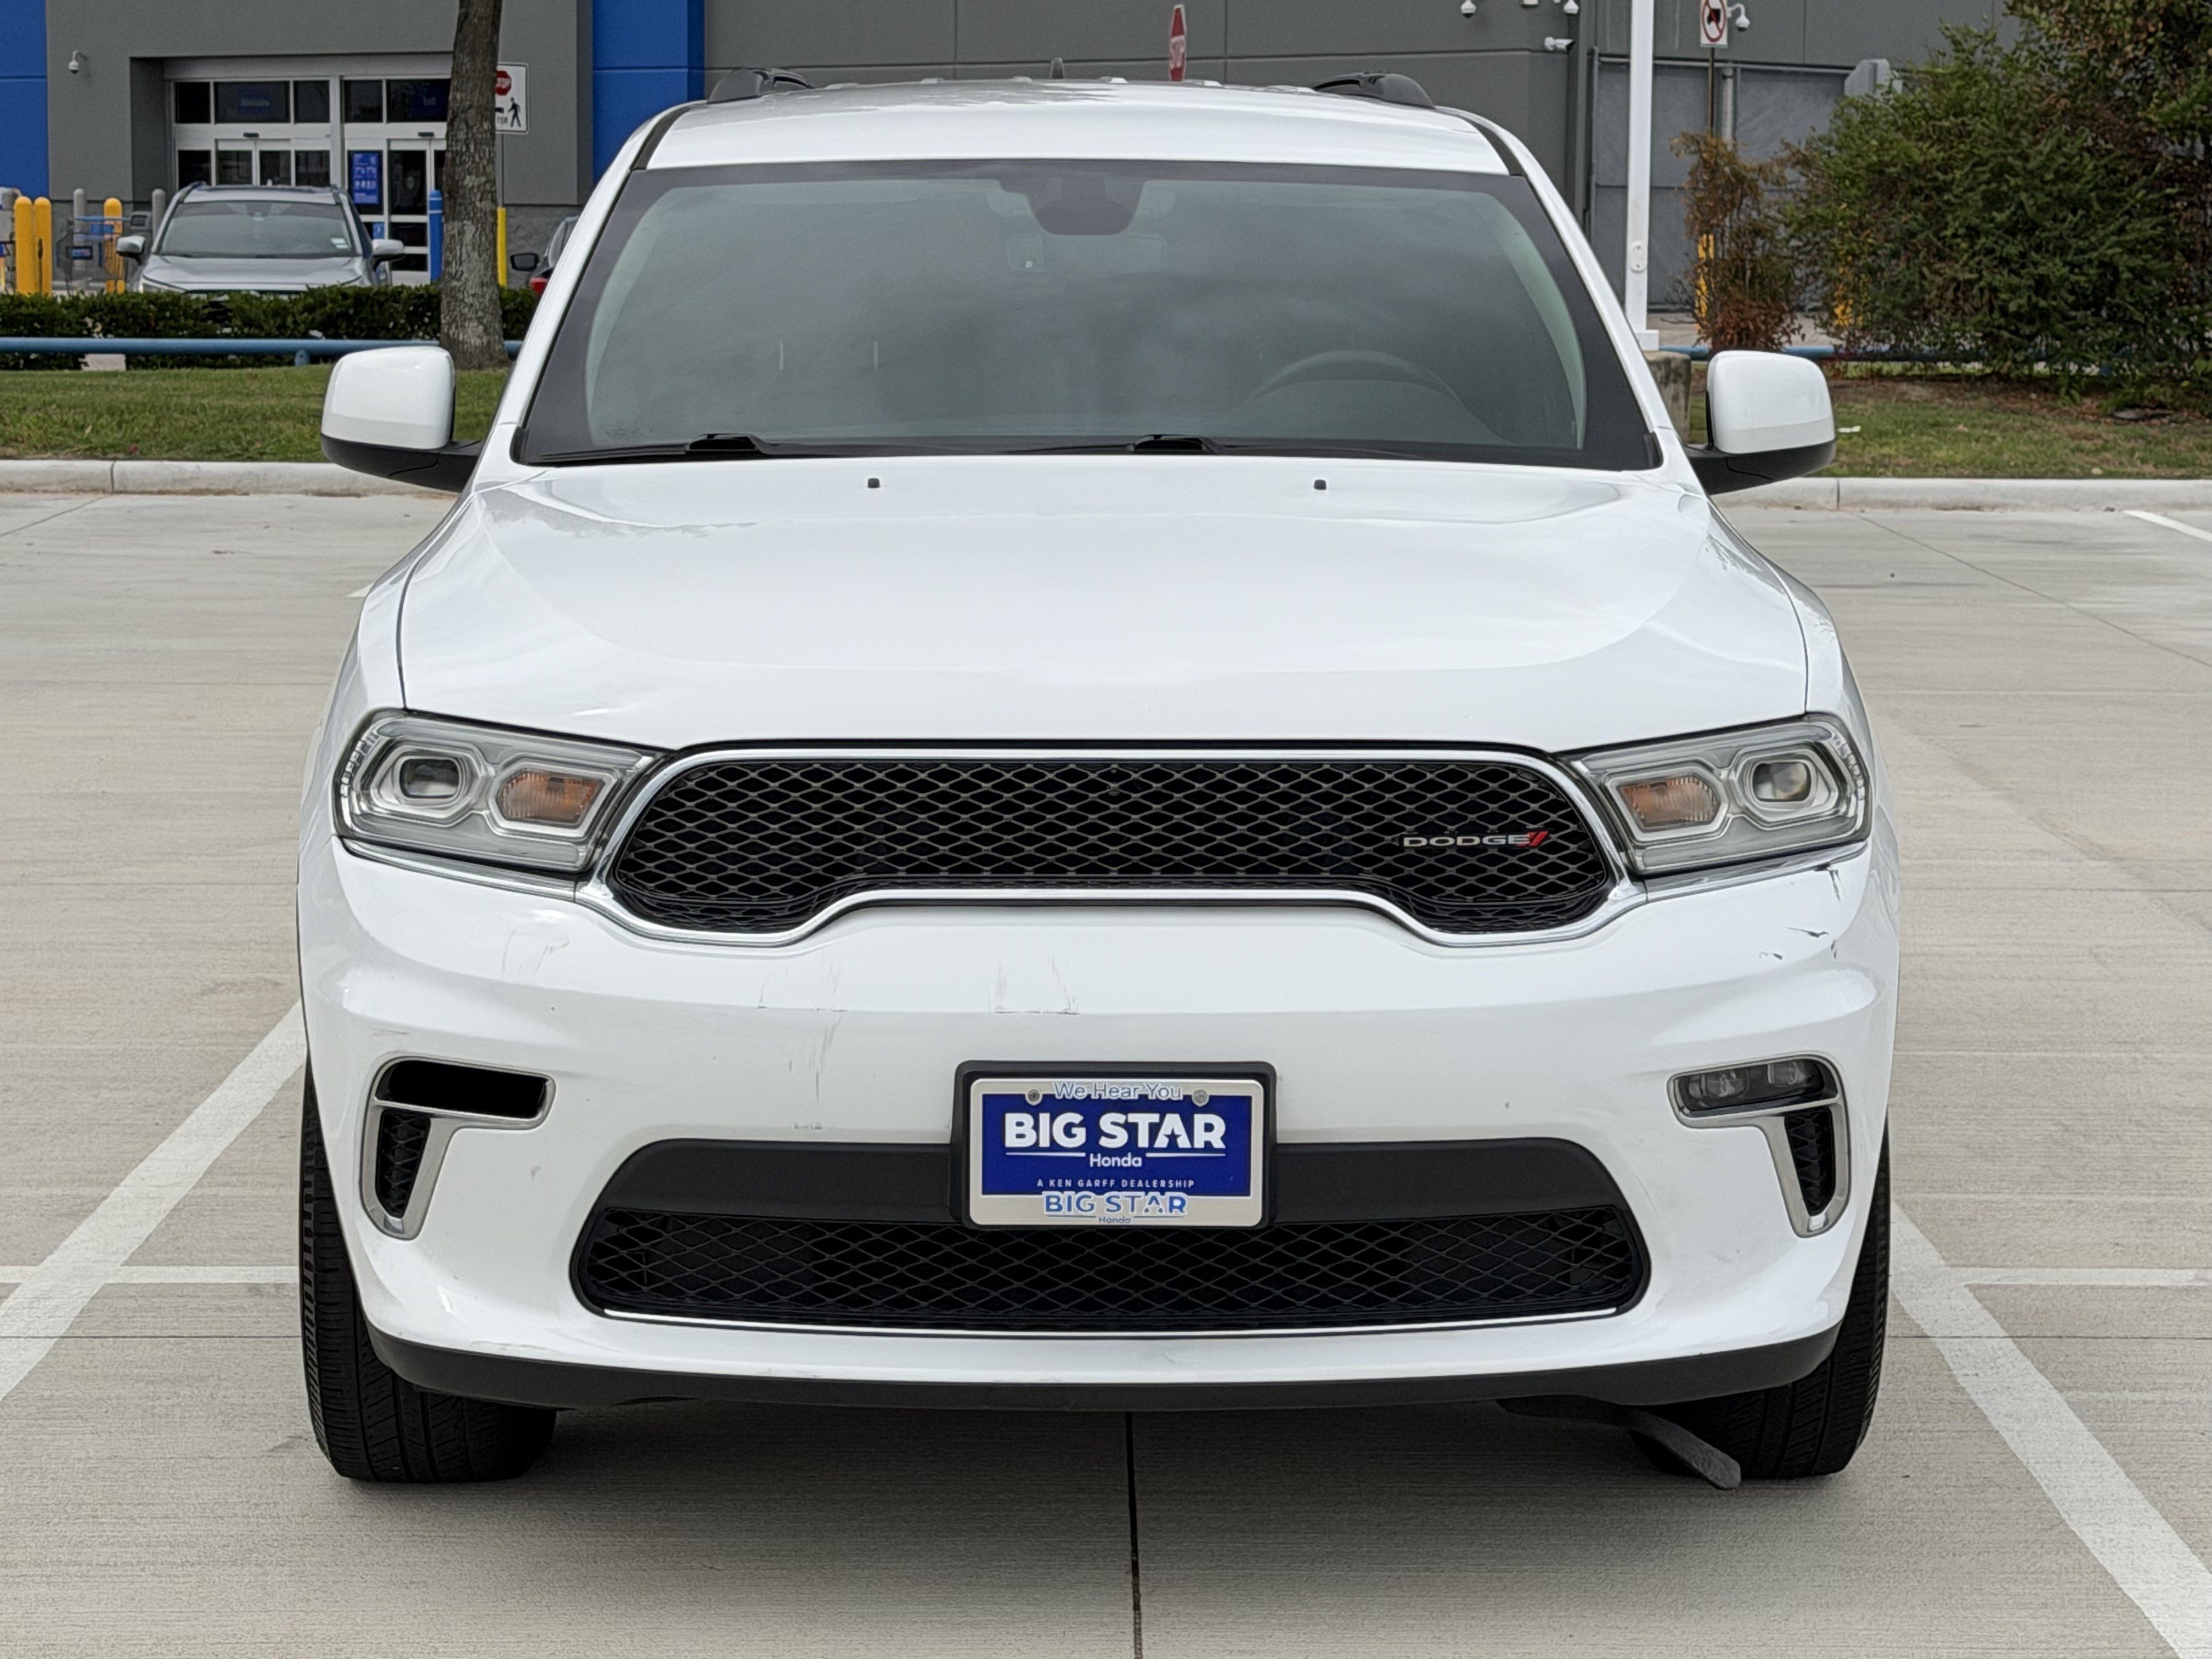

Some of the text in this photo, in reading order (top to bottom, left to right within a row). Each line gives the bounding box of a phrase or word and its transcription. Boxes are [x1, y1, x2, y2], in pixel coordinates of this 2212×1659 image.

[1403, 834, 1531, 847] DODGE
[1053, 1082, 1182, 1098] We Hear You
[1005, 1112, 1226, 1148] BIG STAR
[1090, 1152, 1143, 1167] Honda
[1036, 1178, 1195, 1188] A KEN GARFF DEALERSHIP
[1045, 1193, 1187, 1214] BIG STAR
